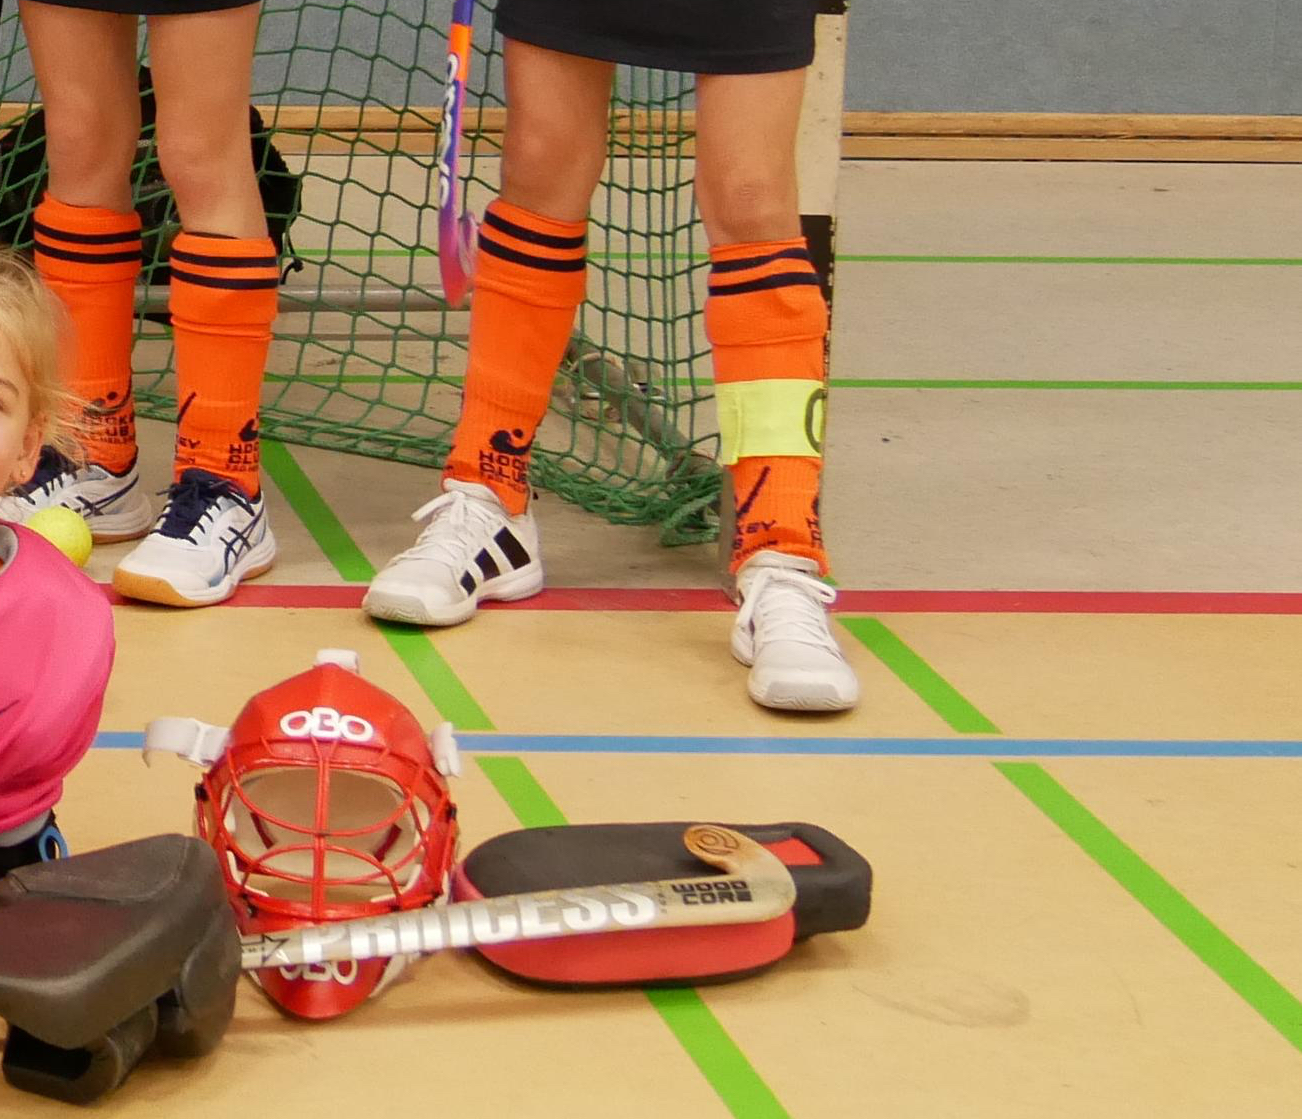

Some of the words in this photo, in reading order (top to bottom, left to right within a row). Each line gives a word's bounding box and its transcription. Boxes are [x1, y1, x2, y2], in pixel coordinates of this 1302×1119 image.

[280, 706, 374, 742] OBO
[670, 880, 747, 894] WOOD
[681, 890, 752, 906] CORE
[301, 883, 657, 964] PRINCESS
